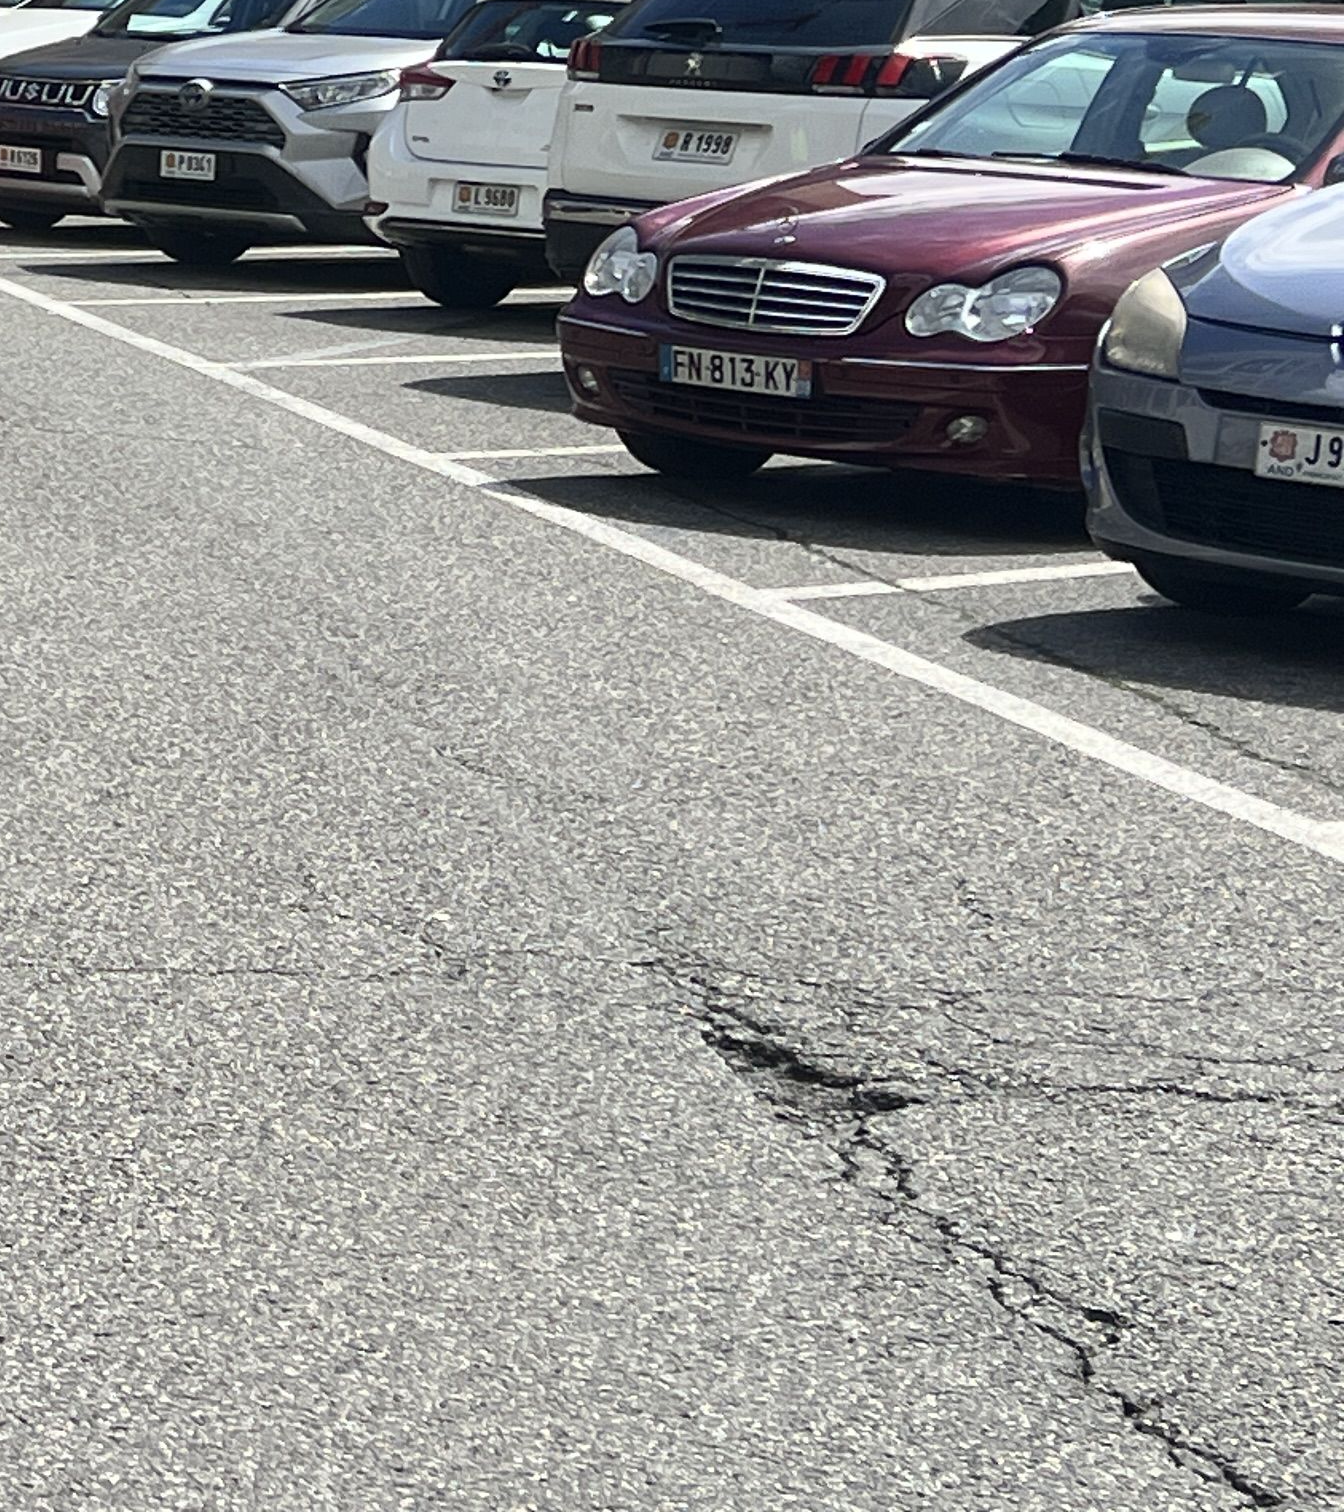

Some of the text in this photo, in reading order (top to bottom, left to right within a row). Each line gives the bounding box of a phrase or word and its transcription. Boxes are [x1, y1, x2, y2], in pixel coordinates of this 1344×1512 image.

[696, 133, 733, 155] 1998
[673, 349, 797, 393] FN-813-KY
[1304, 433, 1322, 466] J
